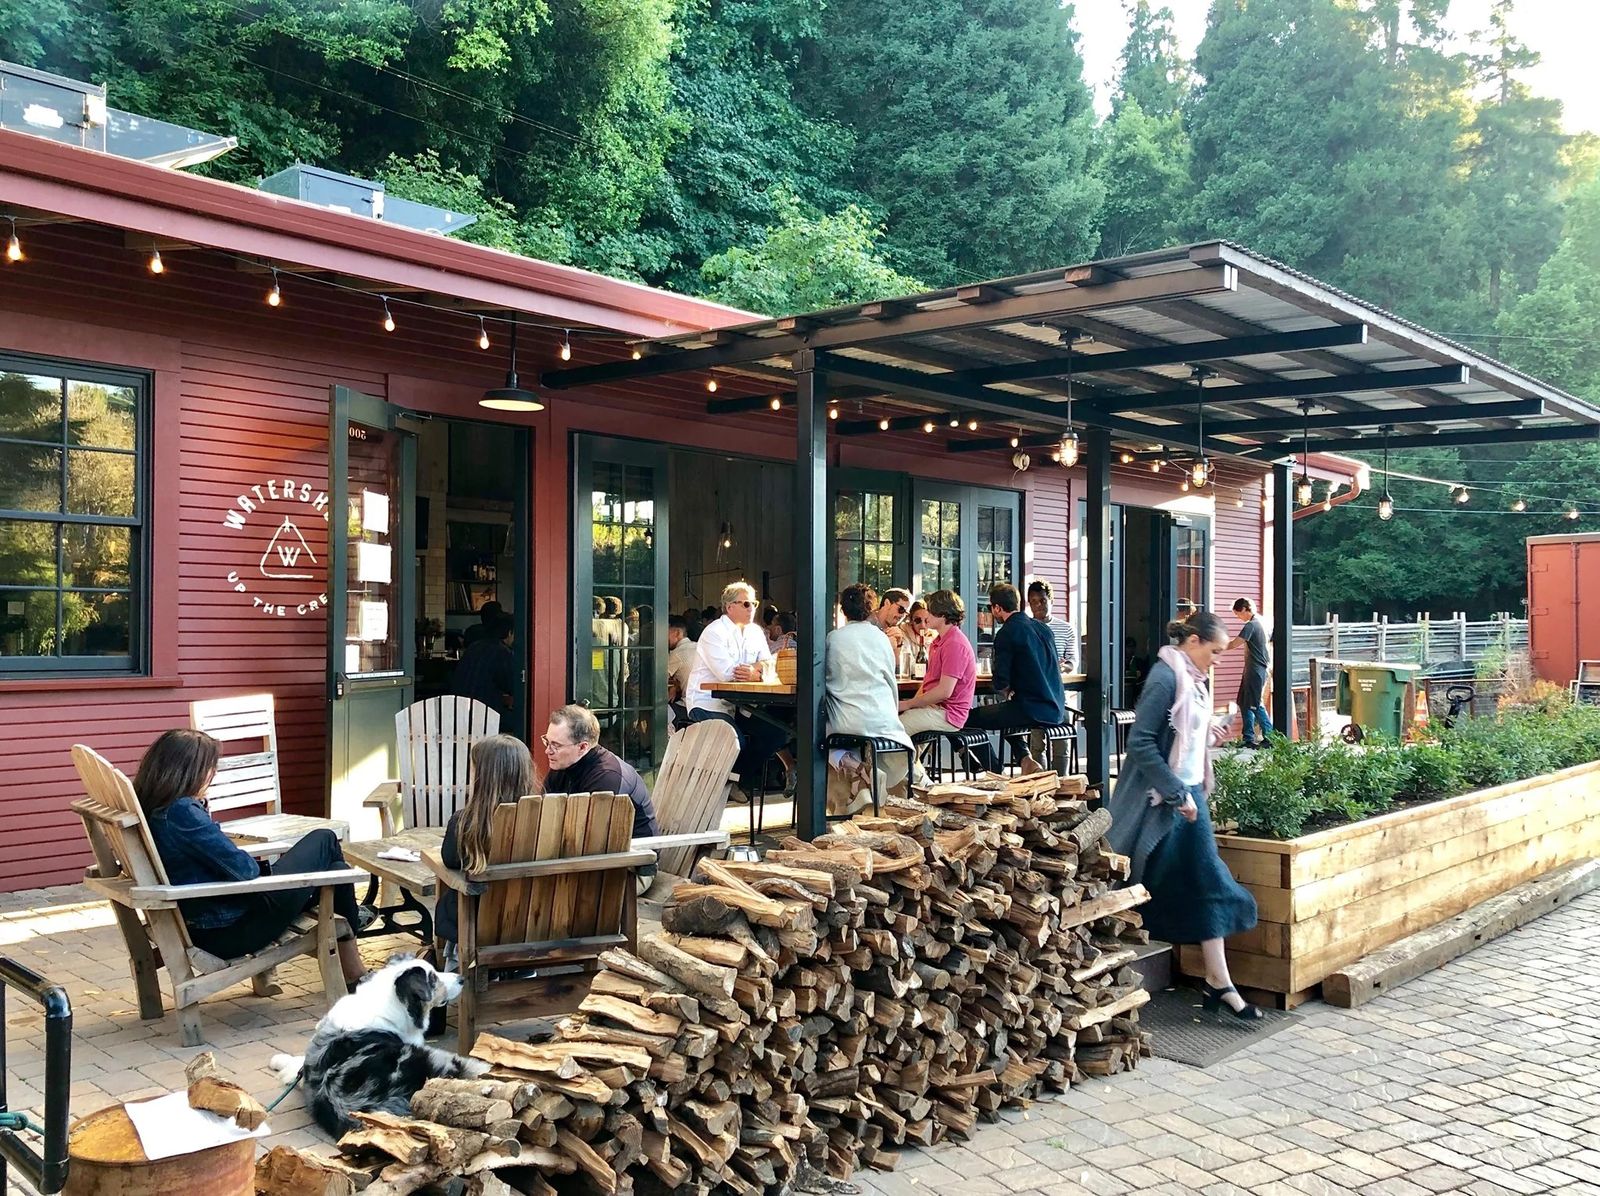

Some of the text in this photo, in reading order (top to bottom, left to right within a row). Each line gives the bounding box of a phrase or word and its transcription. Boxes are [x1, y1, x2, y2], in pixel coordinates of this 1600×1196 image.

[223, 480, 328, 530] WATERSH
[277, 545, 301, 567] W
[227, 571, 247, 593] UP
[253, 597, 286, 616] THE
